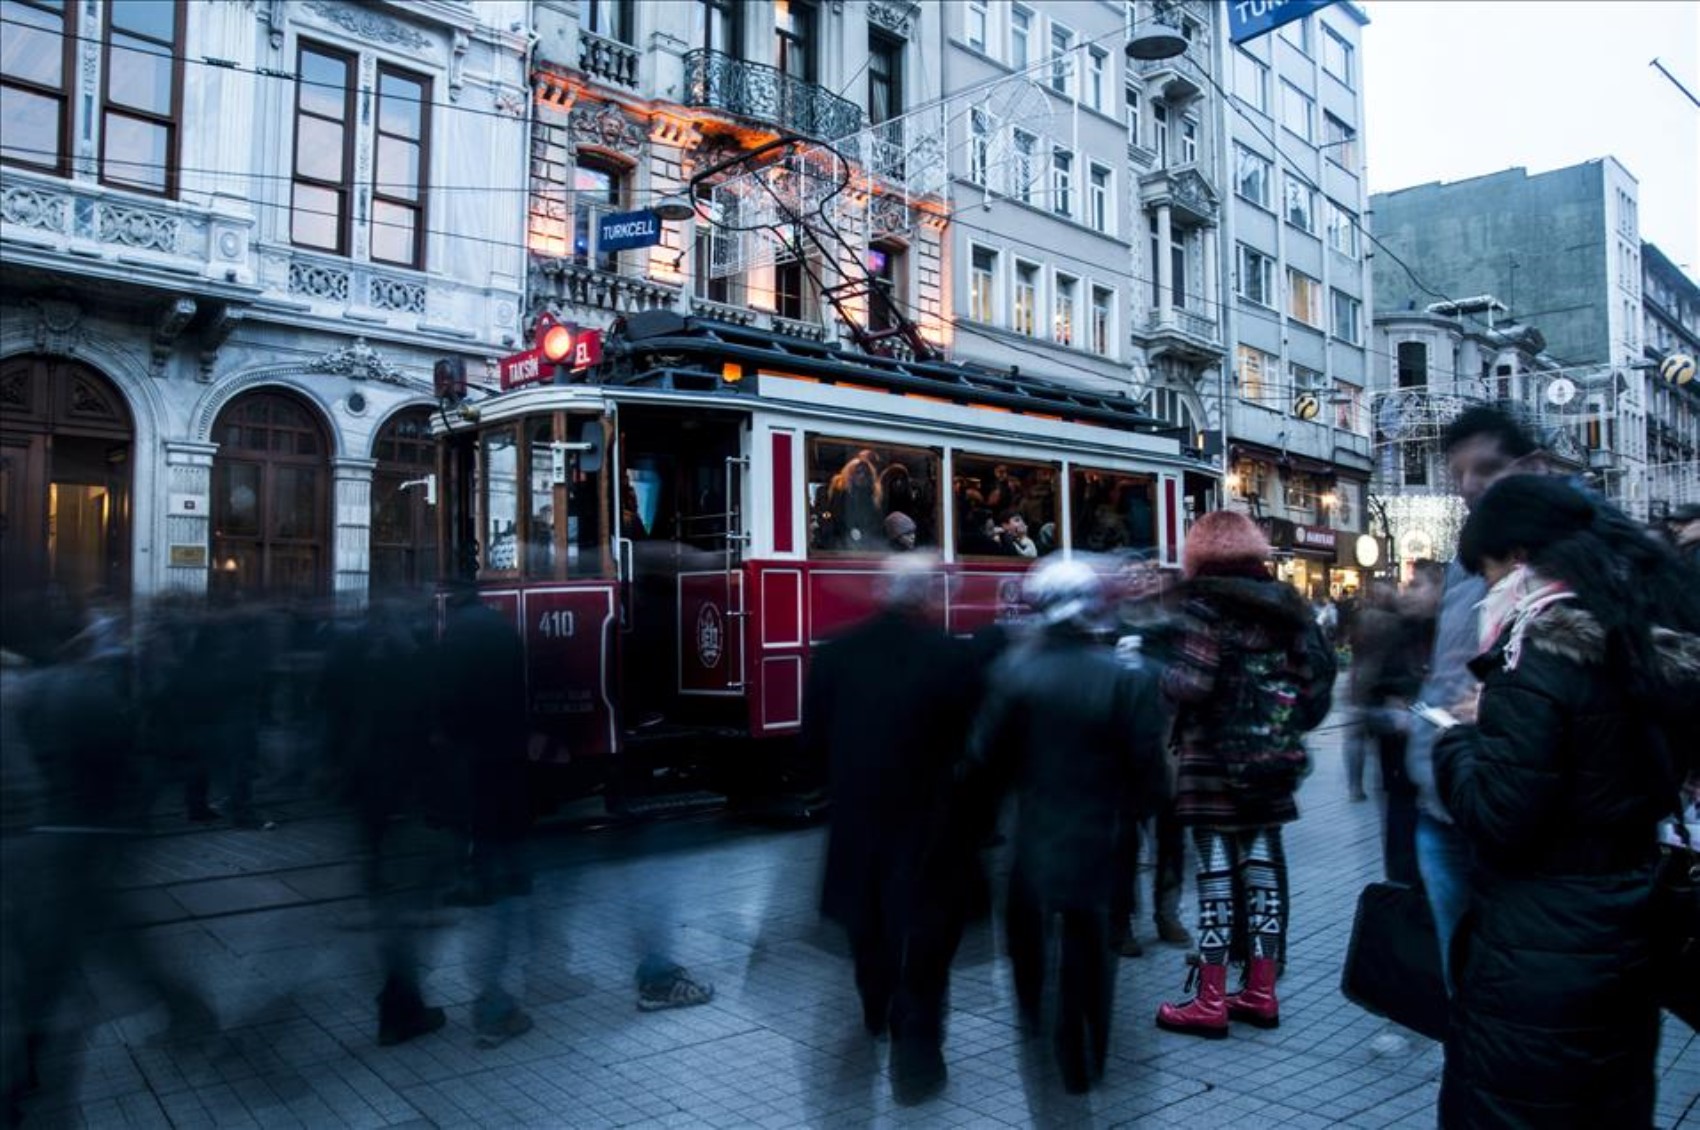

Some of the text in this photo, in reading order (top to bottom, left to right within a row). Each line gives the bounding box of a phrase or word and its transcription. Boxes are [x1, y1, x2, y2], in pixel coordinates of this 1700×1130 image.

[1236, 0, 1290, 24] TUR
[603, 220, 654, 239] TURKCELL
[575, 343, 591, 364] EL
[539, 610, 574, 638] 410
